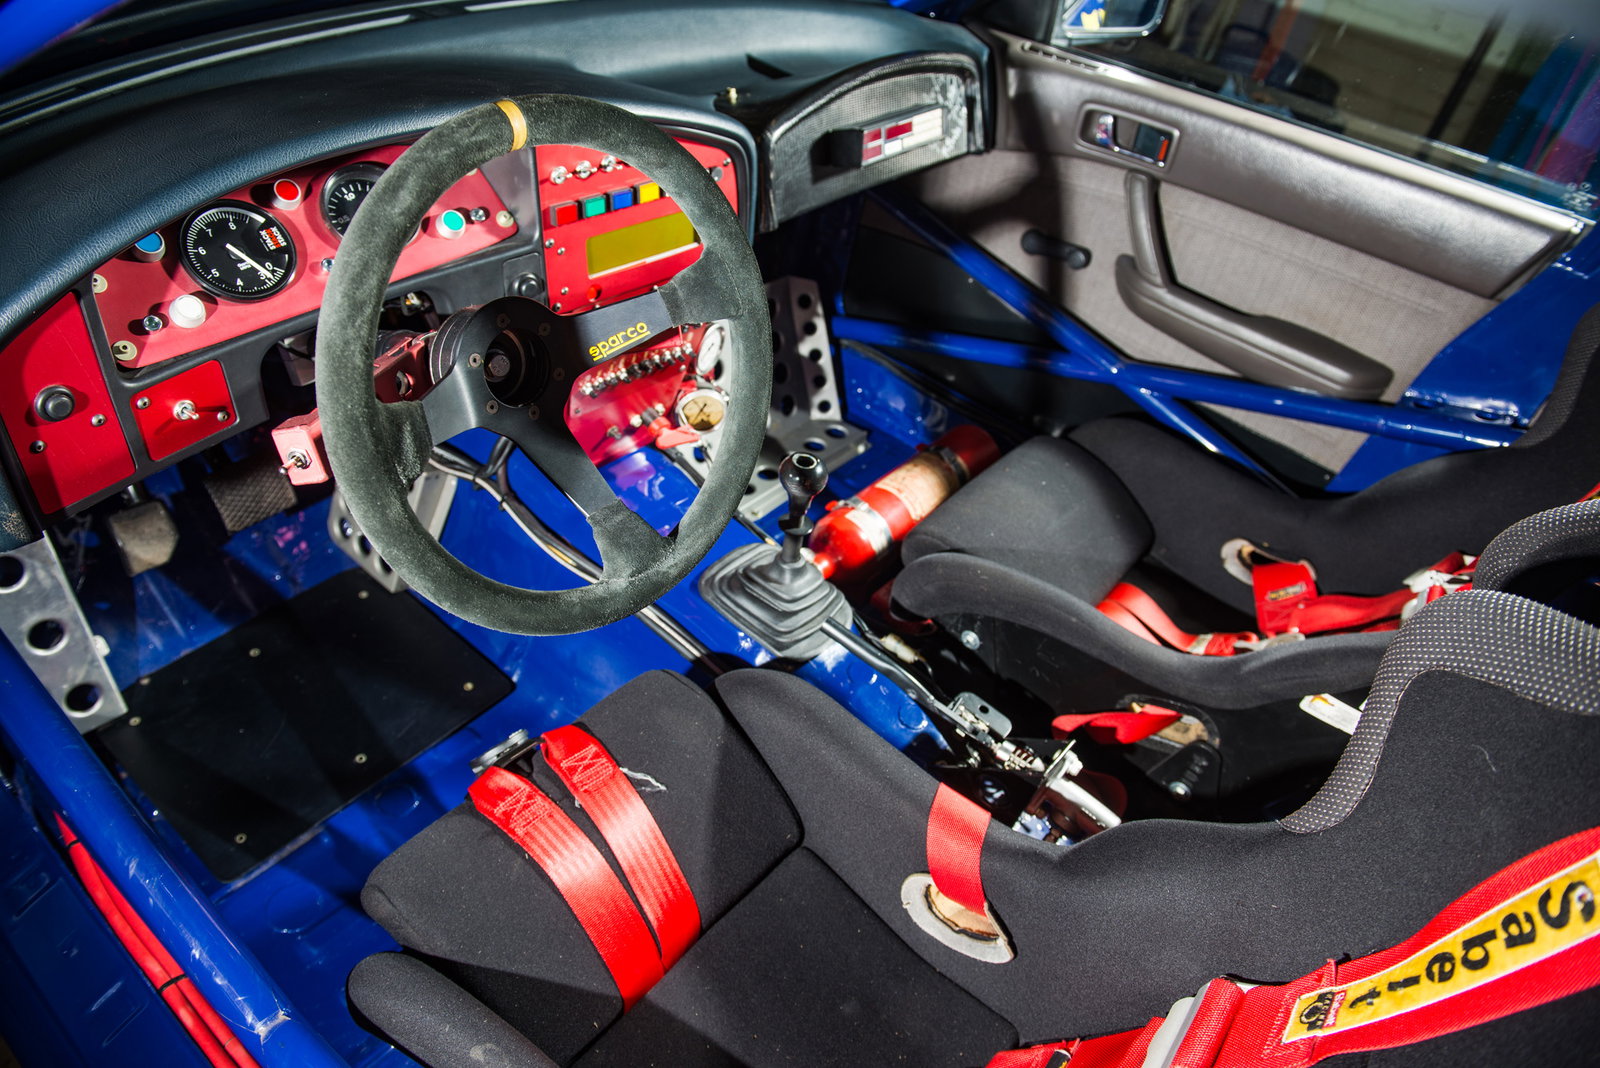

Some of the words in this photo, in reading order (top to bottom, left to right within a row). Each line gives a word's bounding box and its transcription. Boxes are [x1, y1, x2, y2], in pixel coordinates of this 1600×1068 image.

[228, 222, 237, 230] 8
[206, 229, 213, 238] 7
[198, 246, 207, 255] 6
[265, 262, 273, 270] 0
[211, 268, 220, 278] 5
[236, 277, 244, 286] 4
[589, 322, 648, 358] sparco
[1349, 880, 1596, 1009] Sabelt
